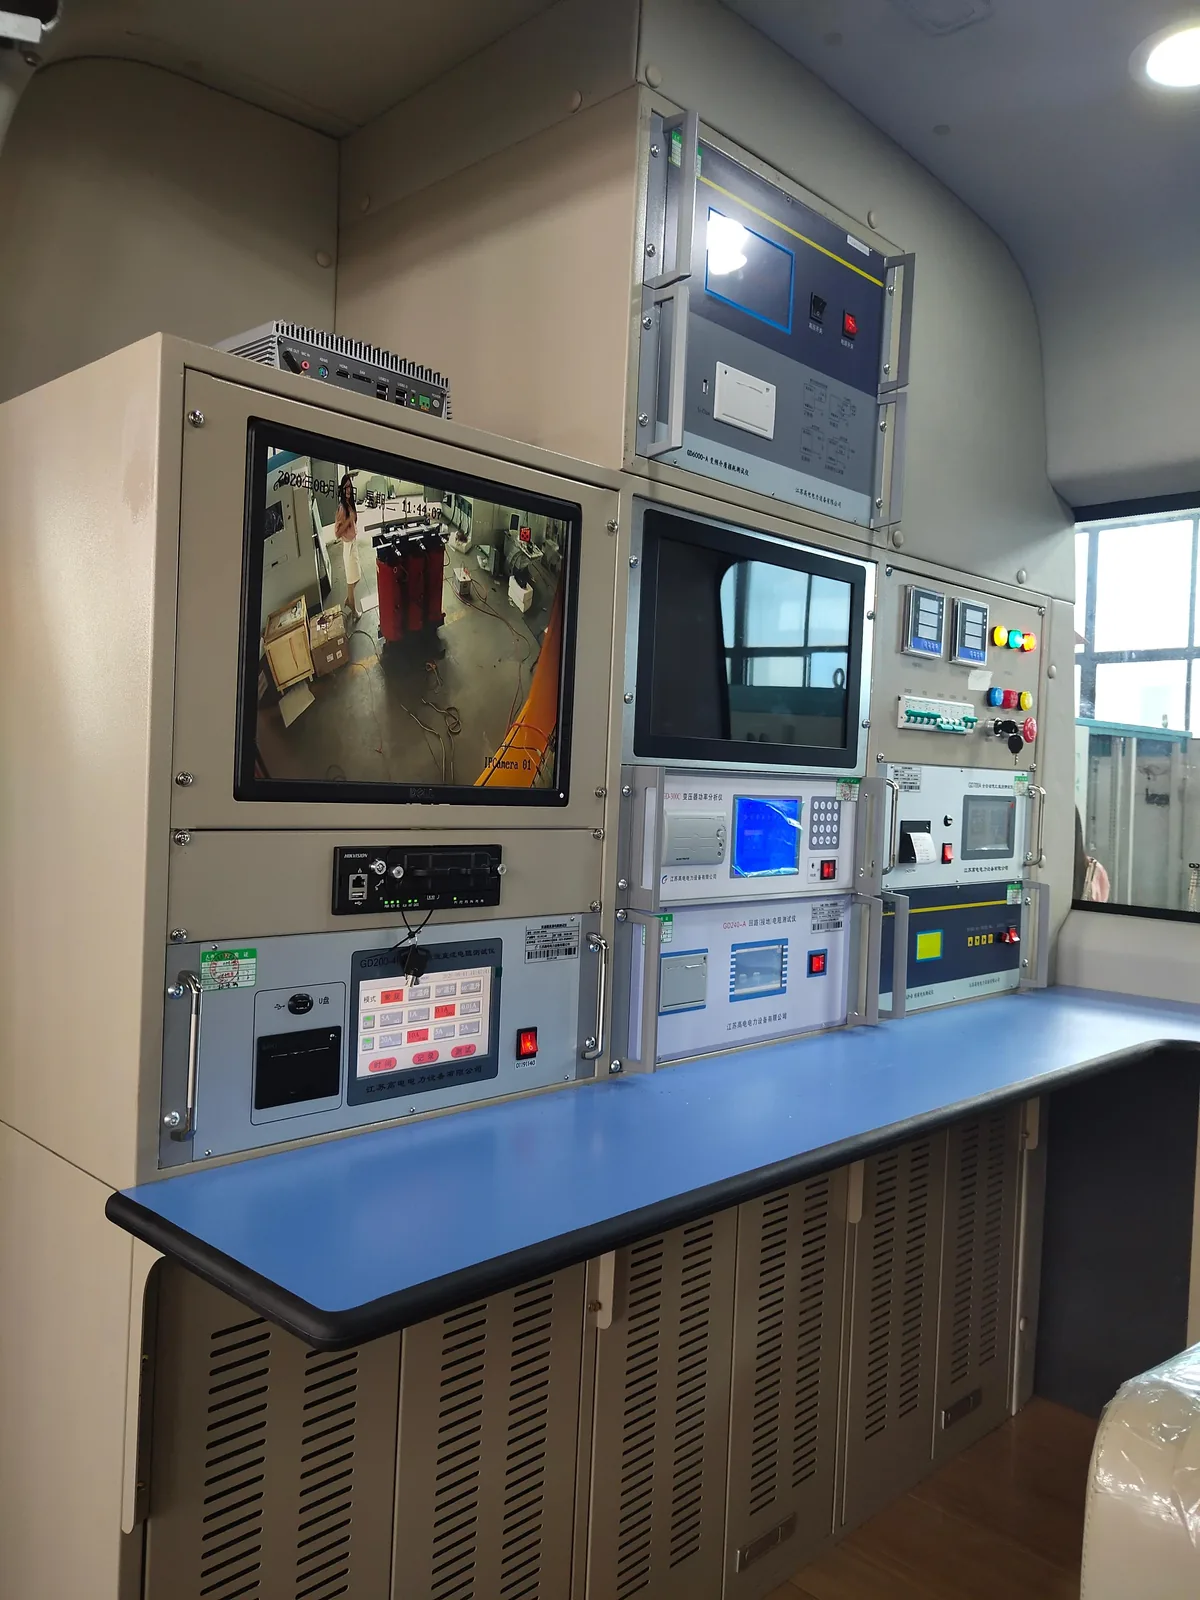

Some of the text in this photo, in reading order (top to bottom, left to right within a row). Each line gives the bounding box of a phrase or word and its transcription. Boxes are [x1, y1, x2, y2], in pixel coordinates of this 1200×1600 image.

[484, 756, 532, 770] IPCamera 01
[722, 920, 746, 930] GD240-A
[318, 996, 330, 1005] U盘
[363, 995, 377, 1004] 模式
[726, 1012, 787, 1031] 江苏高电电力设备有限公司
[365, 1065, 483, 1094] 江苏高电电力设备有限公司
